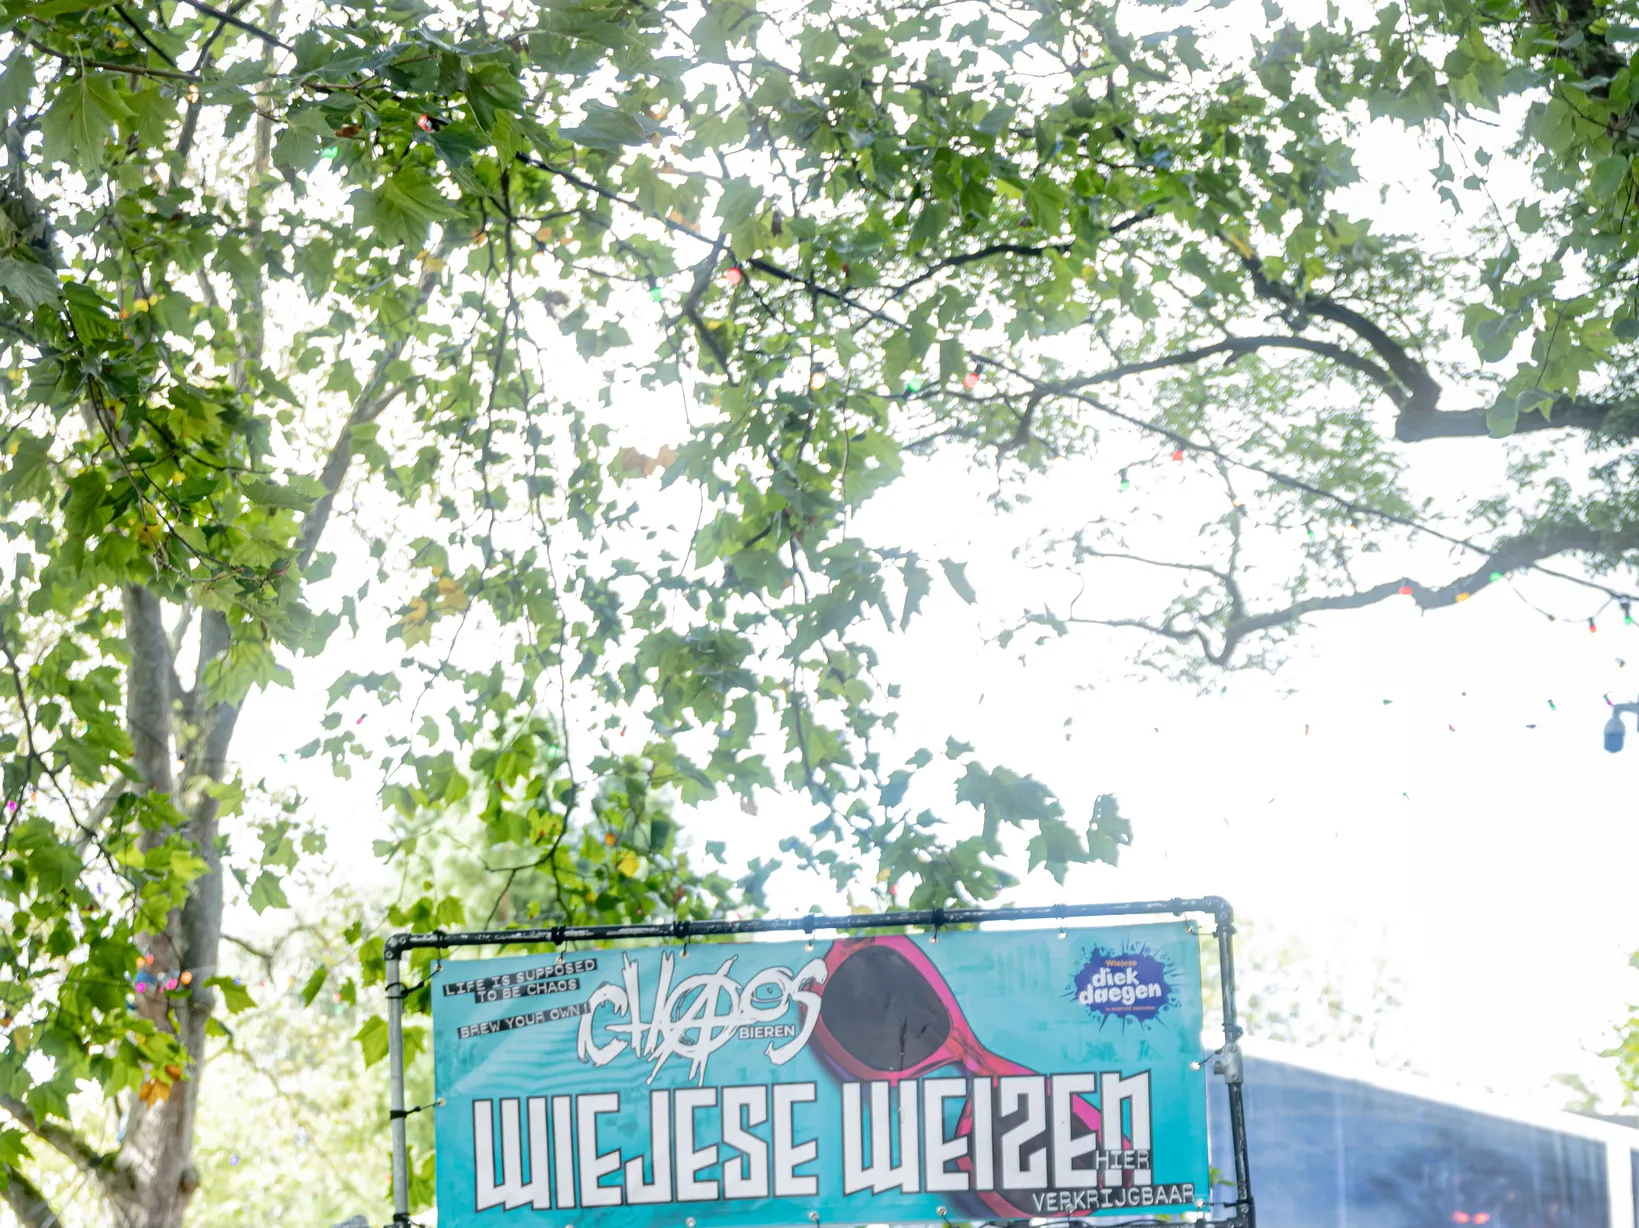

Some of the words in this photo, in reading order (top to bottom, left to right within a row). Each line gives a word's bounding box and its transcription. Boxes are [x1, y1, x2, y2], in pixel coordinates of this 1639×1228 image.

[445, 980, 486, 996] LIFE
[491, 974, 511, 987] IS
[516, 959, 596, 984] SUPPOSED
[1092, 967, 1140, 987] diek
[477, 989, 497, 1003] TO
[502, 986, 521, 999] BE
[527, 978, 578, 996] CHAOS
[1079, 983, 1162, 1006] daegen
[460, 1021, 500, 1039] BREW
[505, 1012, 546, 1029] YOUR
[577, 951, 828, 1087] CHAOS
[738, 1024, 797, 1040] BIEREN
[472, 1082, 818, 1213] WIEJESE
[841, 1069, 1154, 1197] WEIZEN
[1095, 1150, 1150, 1170] HIER
[1032, 1183, 1195, 1213] VERKRIJGBAAR
